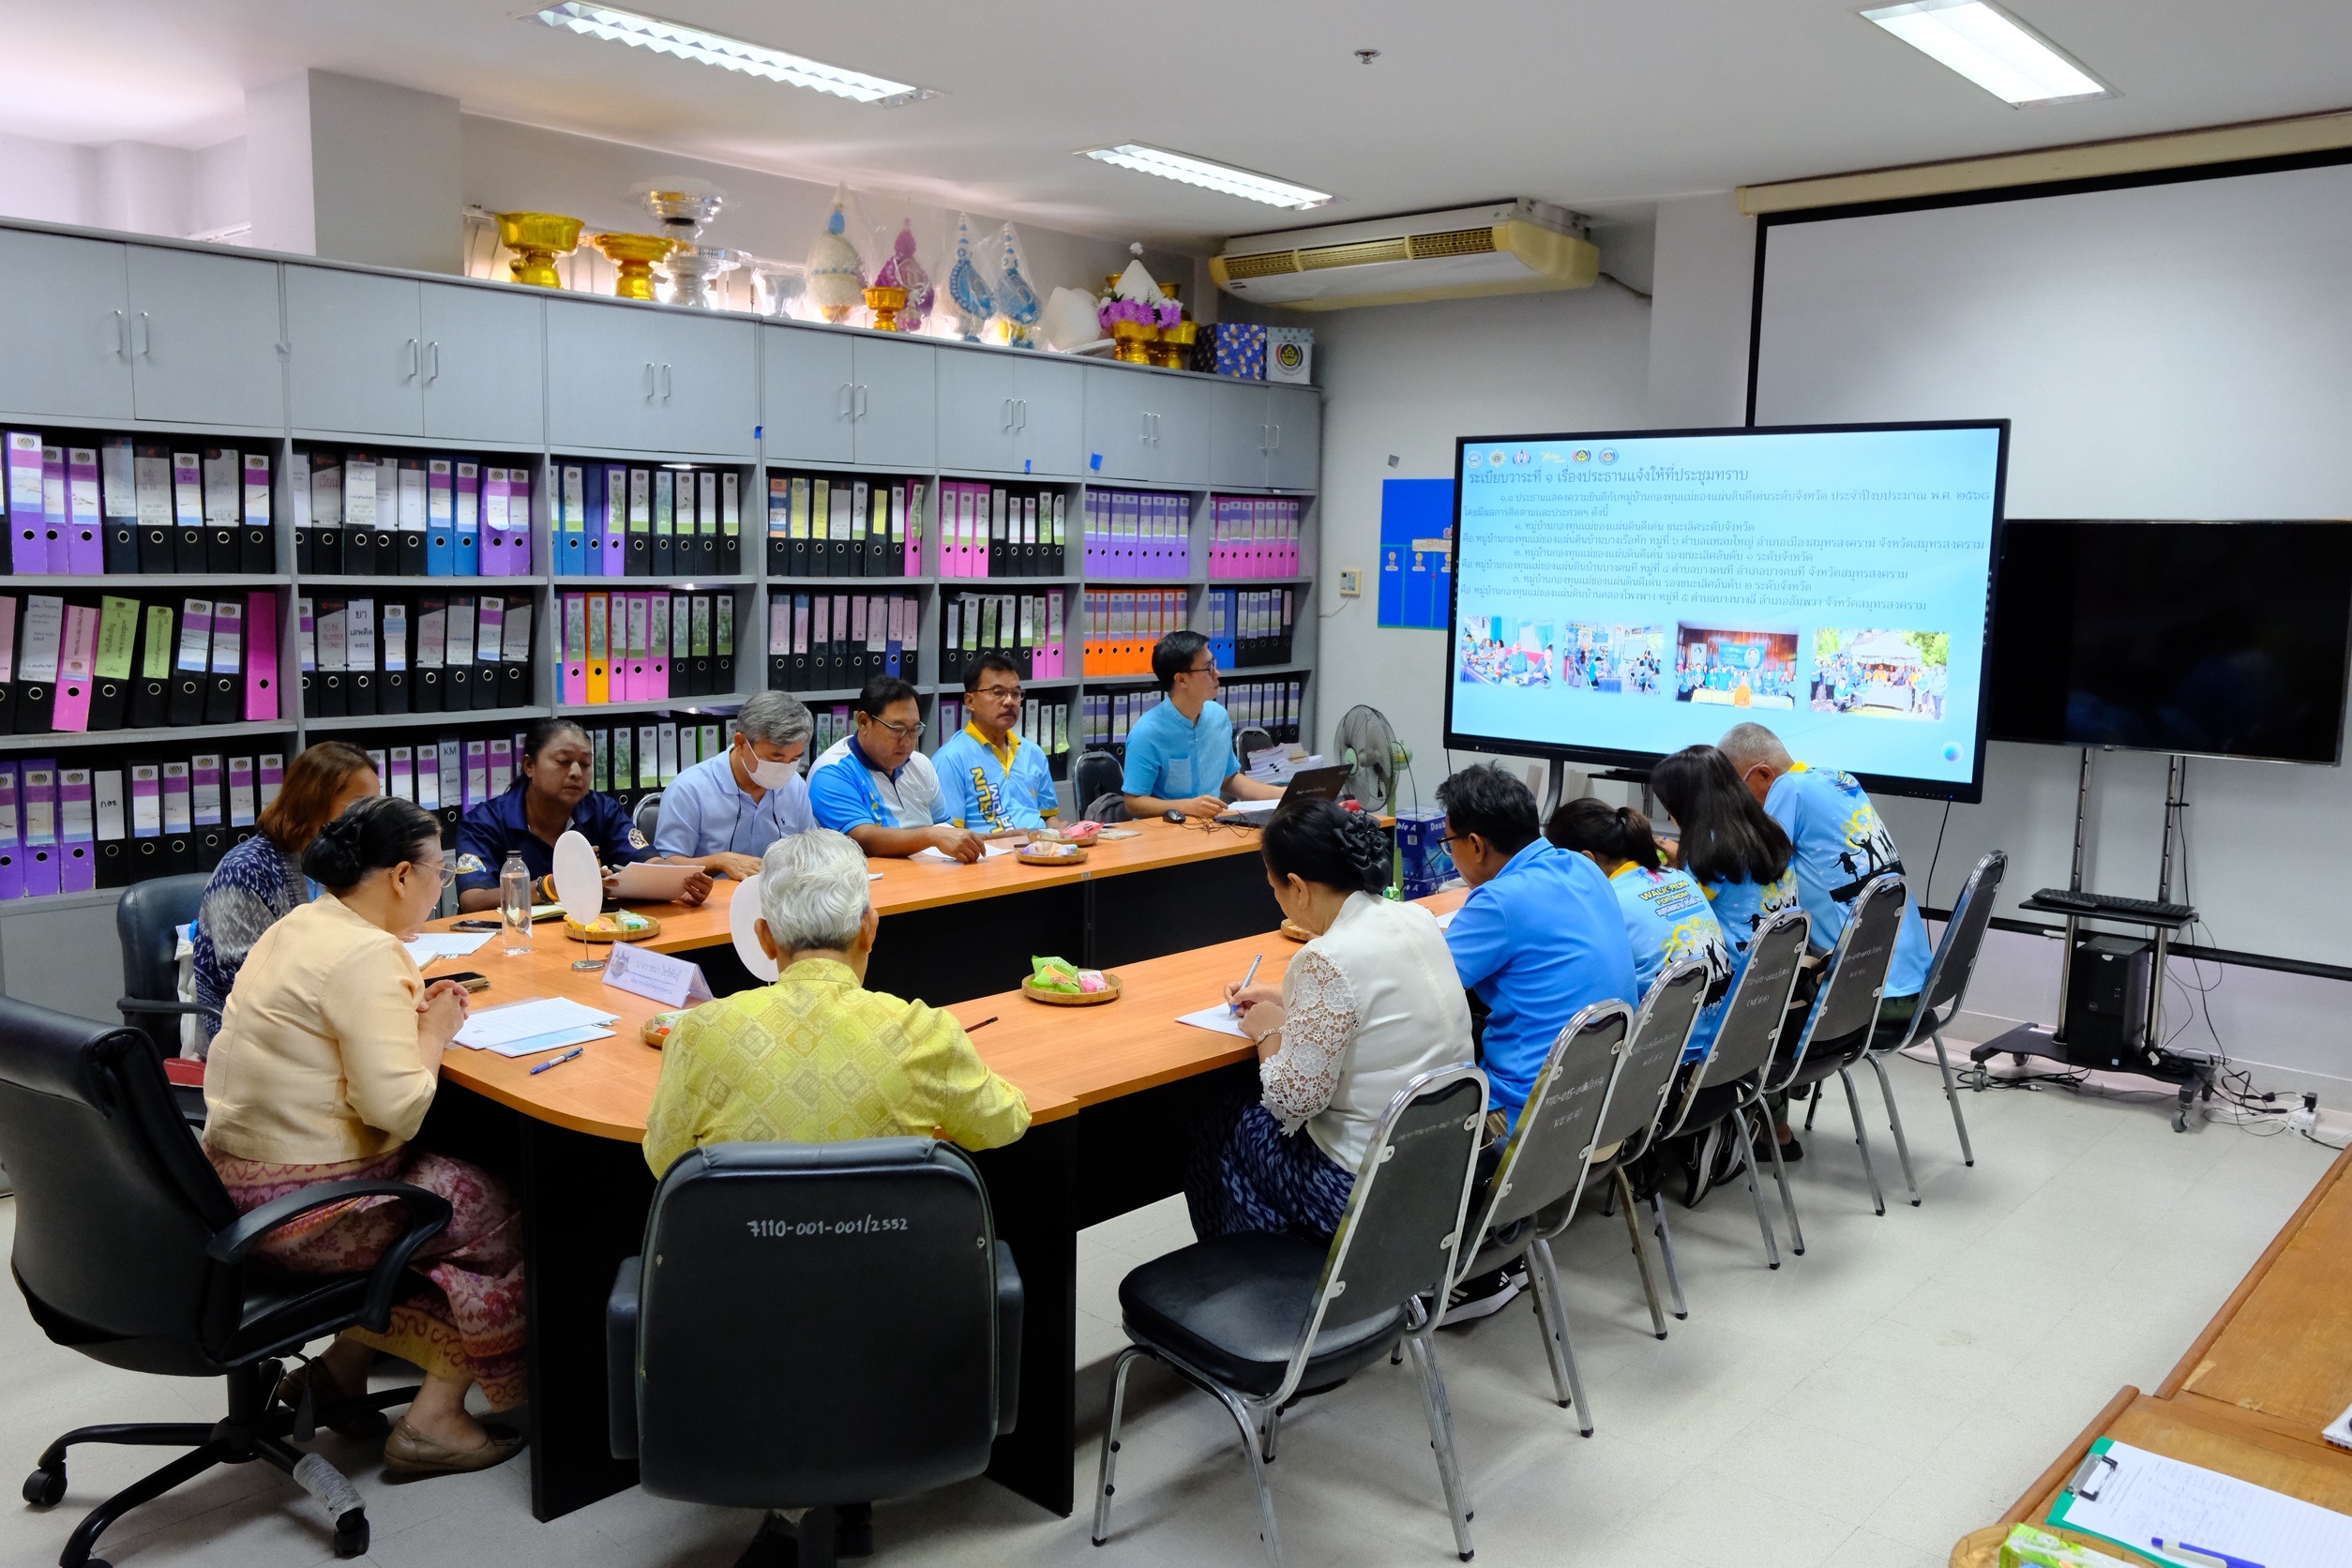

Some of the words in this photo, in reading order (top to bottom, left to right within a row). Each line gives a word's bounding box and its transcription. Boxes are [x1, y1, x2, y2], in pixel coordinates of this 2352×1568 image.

[1469, 466, 1542, 484] ระเบียบวาระที่
[1546, 473, 1553, 483] ๑
[1558, 463, 1749, 486] เรื่องประธานแจ้งให้ที่ประชุมทราบ
[444, 746, 457, 756] KM
[746, 1214, 909, 1237] 7110-001-001/2552
